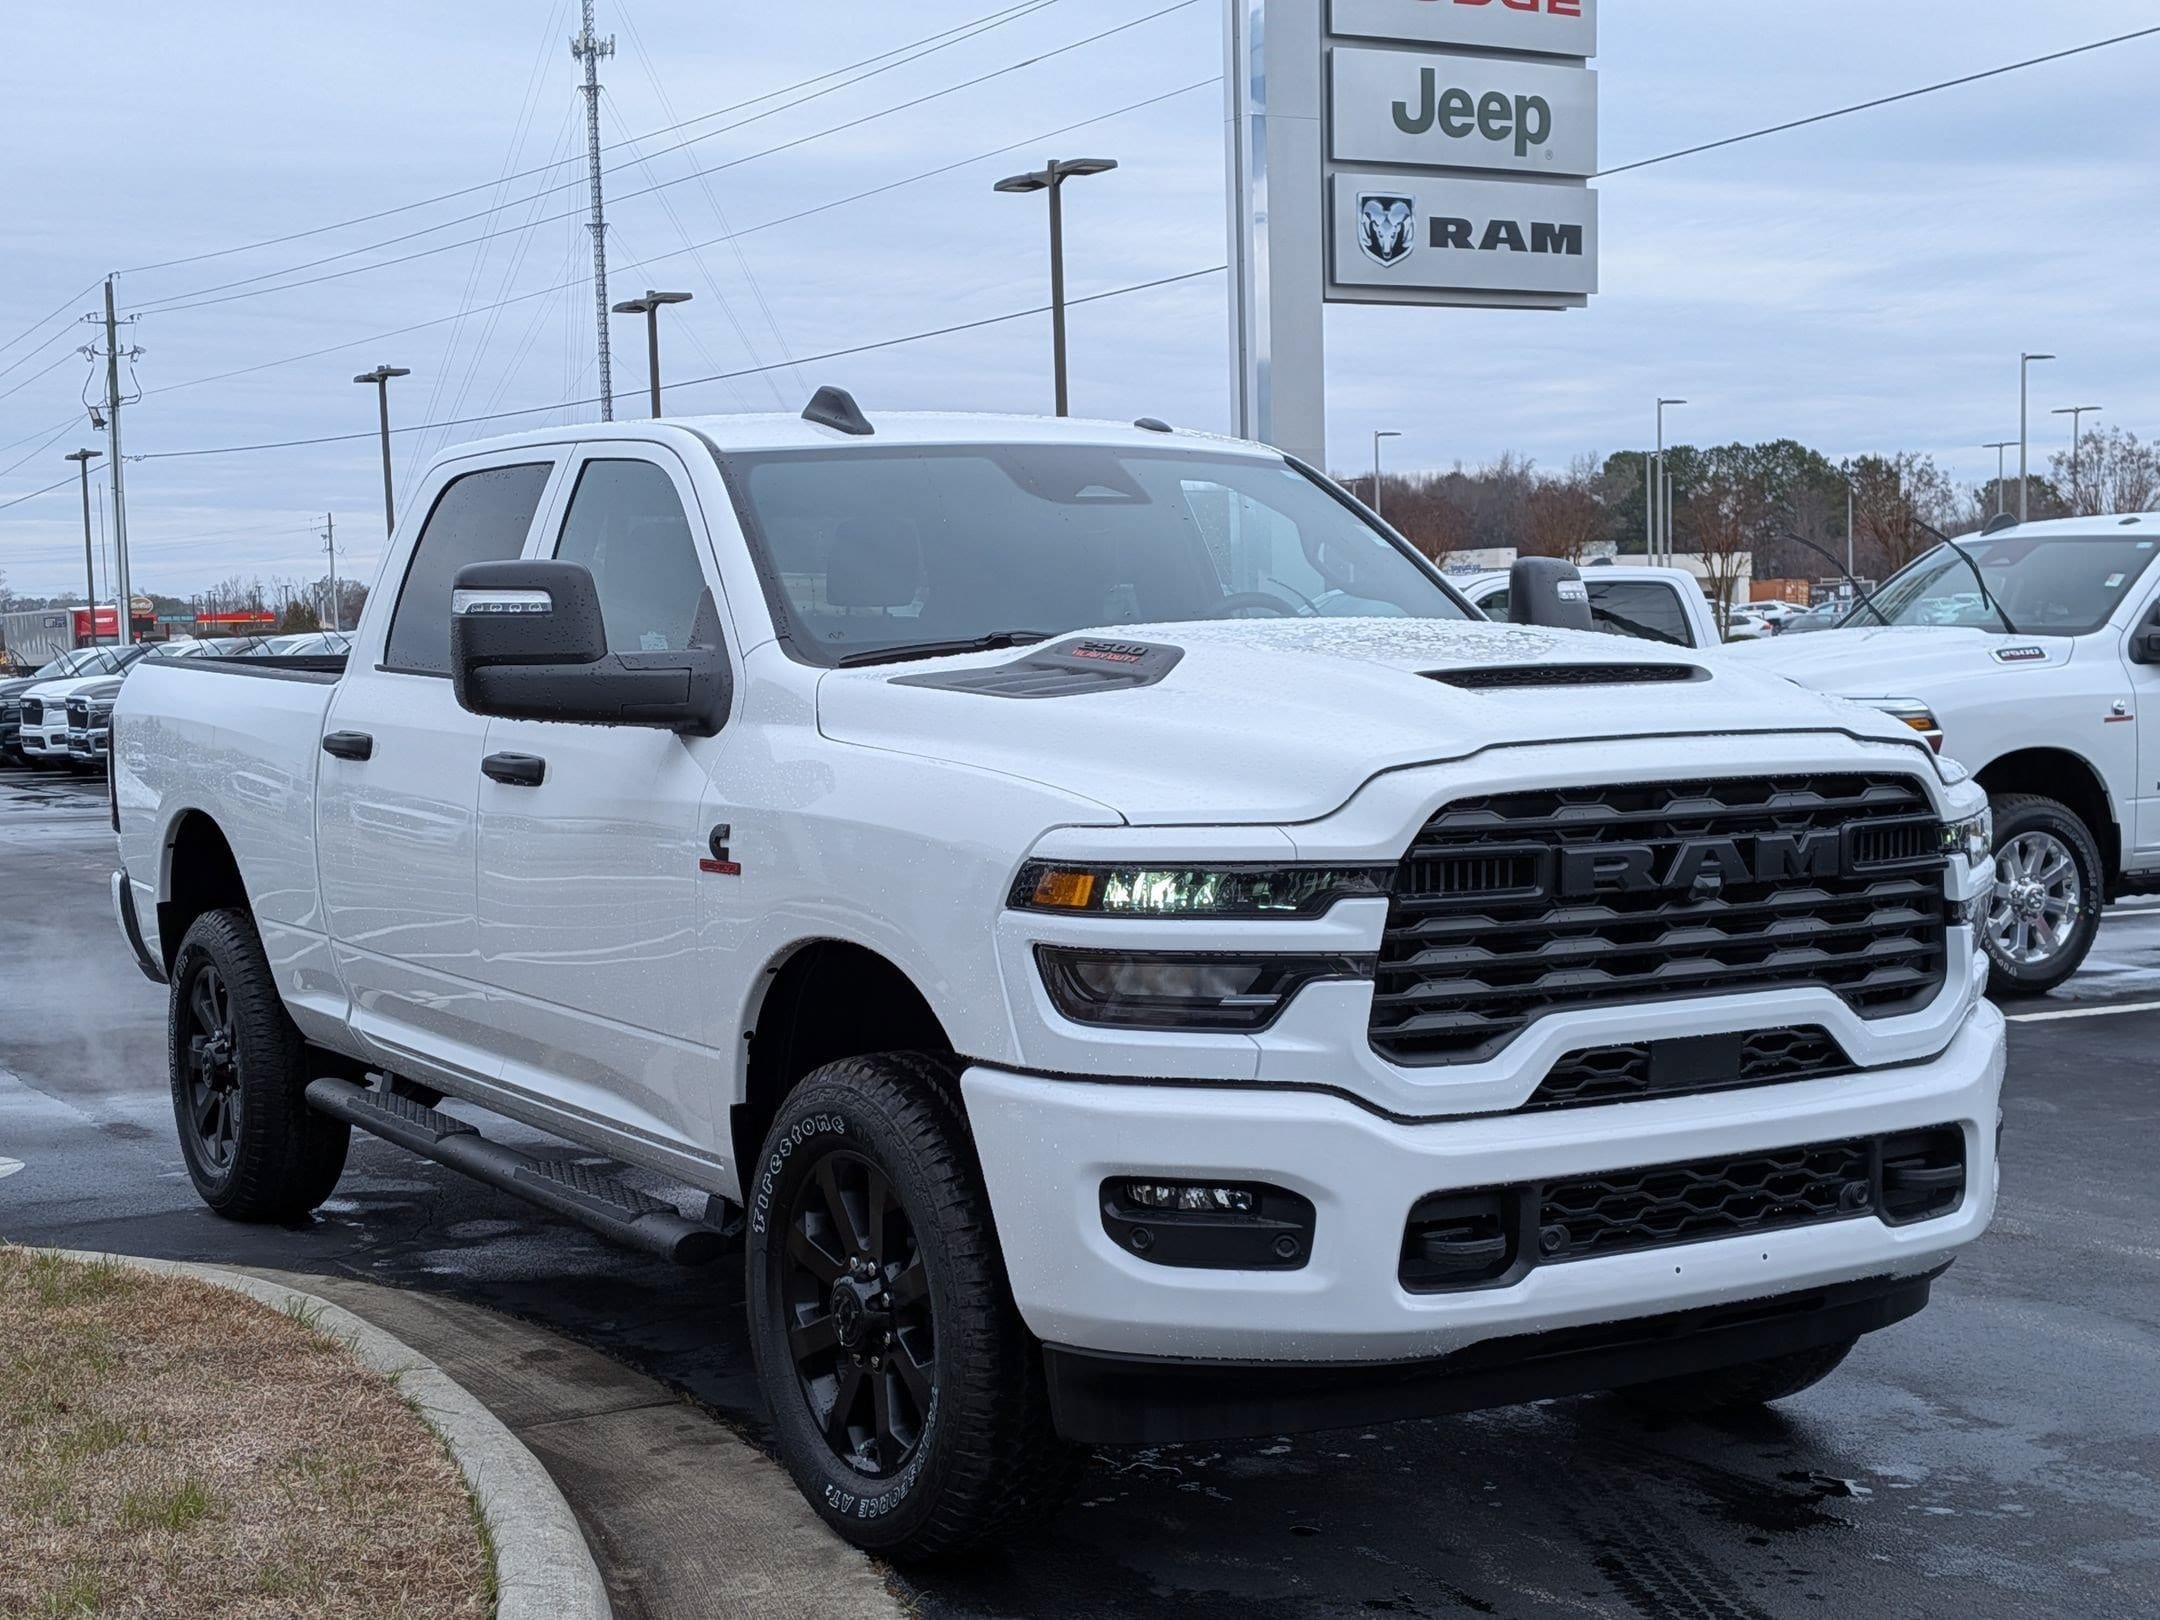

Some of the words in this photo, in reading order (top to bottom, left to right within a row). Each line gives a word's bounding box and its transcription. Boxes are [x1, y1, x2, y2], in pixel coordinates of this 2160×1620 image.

[1391, 67, 1551, 157] Jeep
[1429, 216, 1583, 256] RAM
[1078, 641, 1149, 656] 2500
[1561, 829, 1840, 898] RAM
